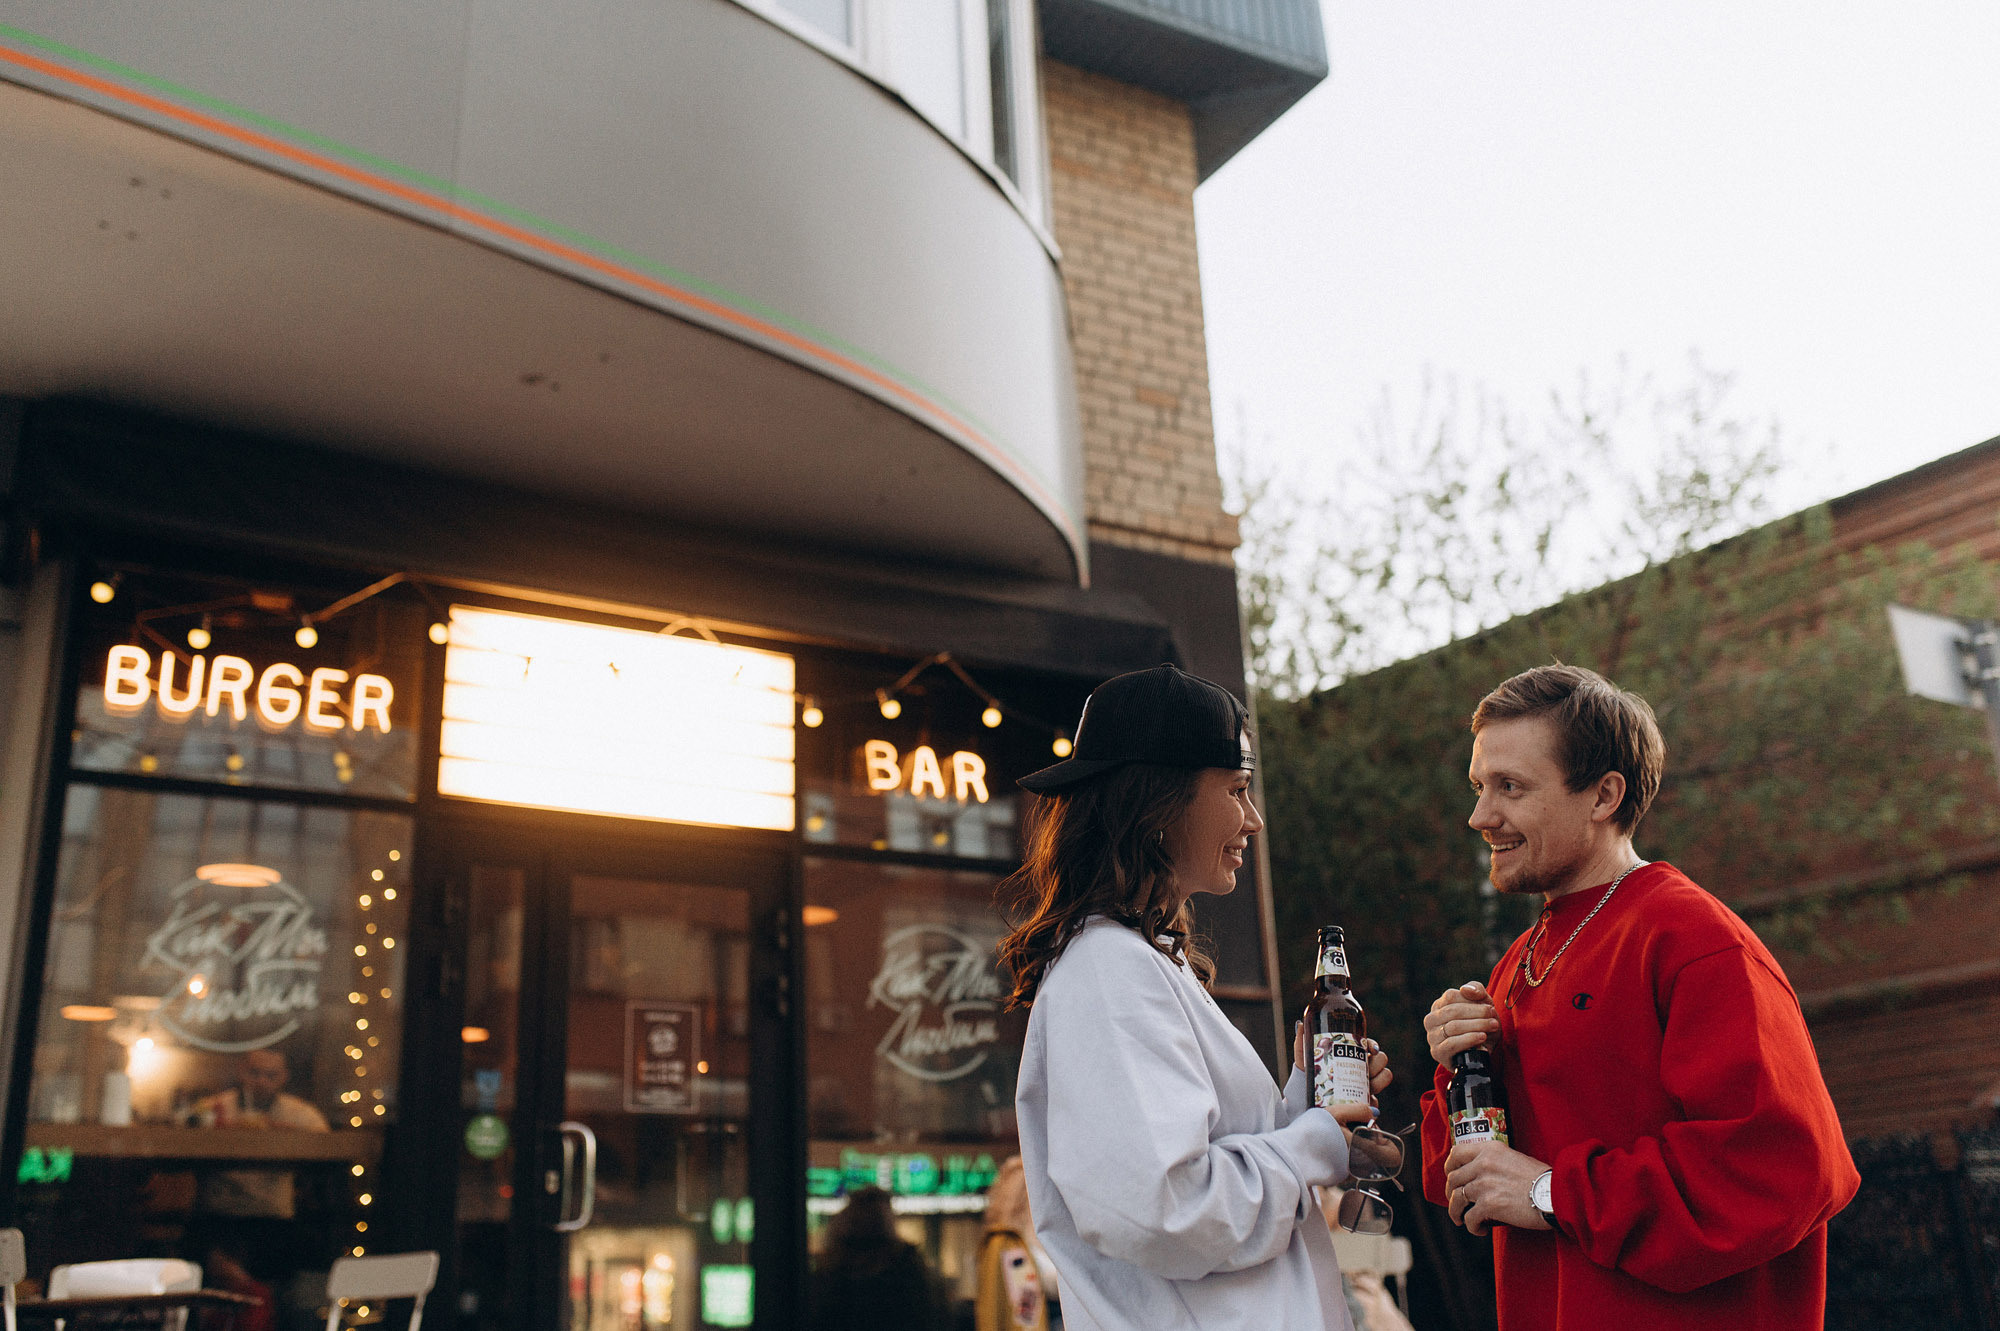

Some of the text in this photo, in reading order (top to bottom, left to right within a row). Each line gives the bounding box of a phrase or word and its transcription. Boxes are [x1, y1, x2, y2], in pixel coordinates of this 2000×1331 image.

[104, 645, 394, 733] BURGER
[865, 739, 989, 804] BAR
[1336, 1045, 1365, 1060] älska
[1456, 1121, 1485, 1136] älska
